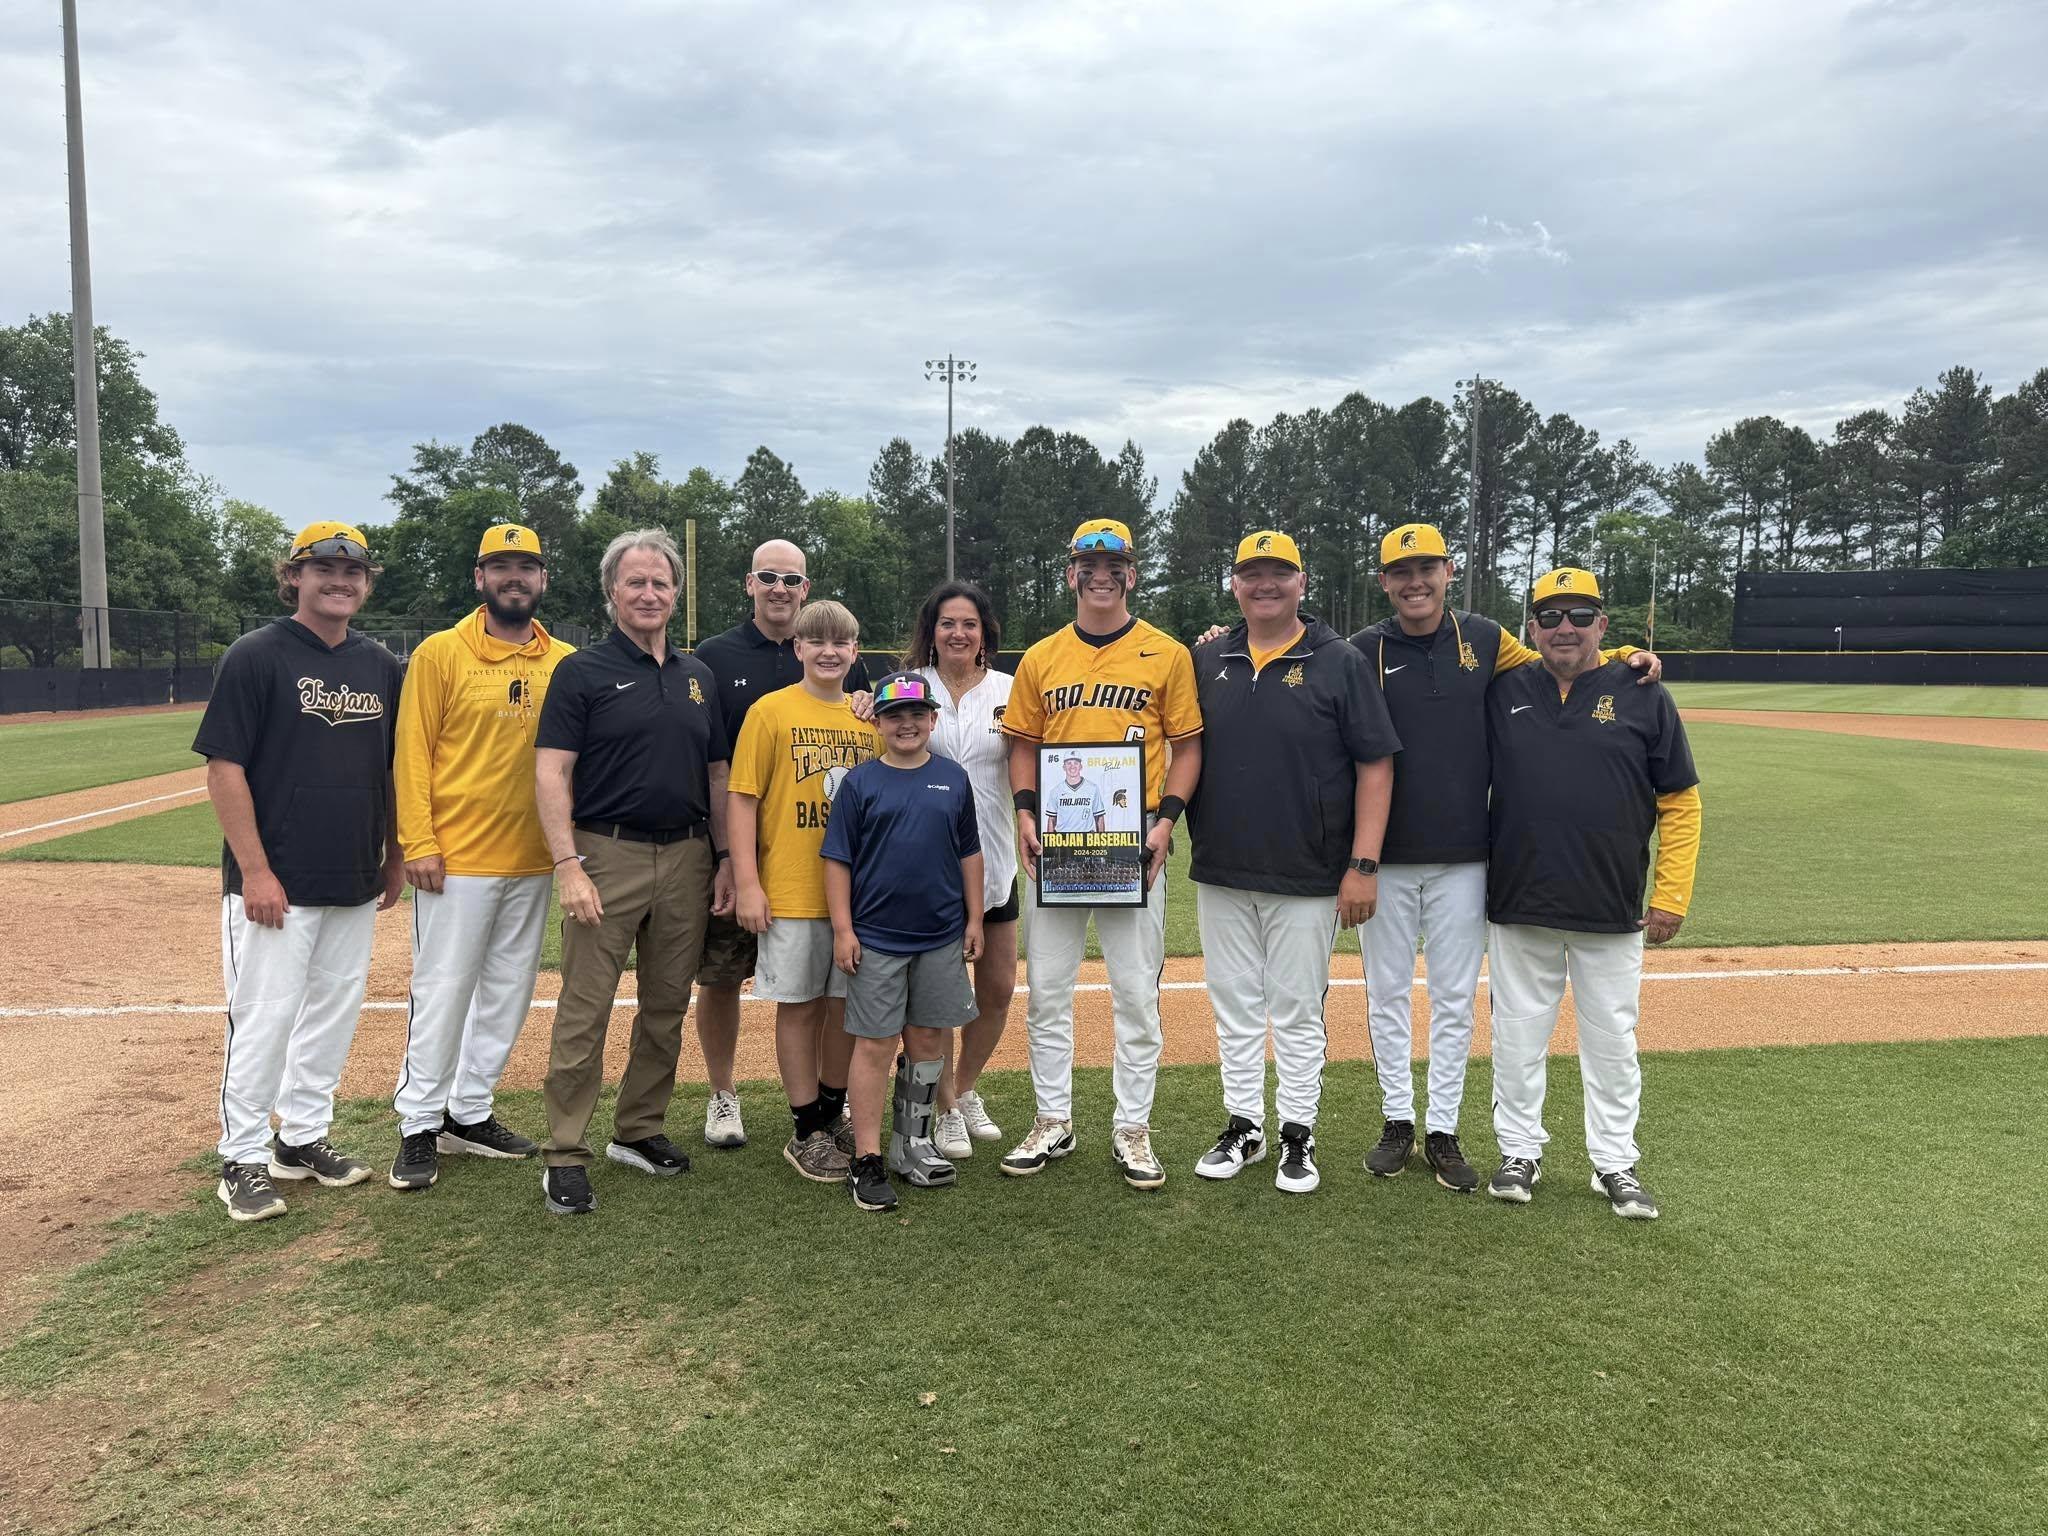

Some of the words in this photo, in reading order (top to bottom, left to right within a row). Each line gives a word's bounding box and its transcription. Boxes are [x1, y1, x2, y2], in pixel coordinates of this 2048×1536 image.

[467, 669, 535, 678] FAYETTEVLE
[297, 677, 382, 721] Trojans
[1043, 682, 1152, 714] TROJANS
[791, 727, 857, 746] FAYETTEVILLE
[1059, 798, 1091, 807] TROJANS
[796, 801, 830, 829] BAS
[1043, 833, 1084, 848] TROJAN
[1086, 832, 1139, 847] BASEBALL
